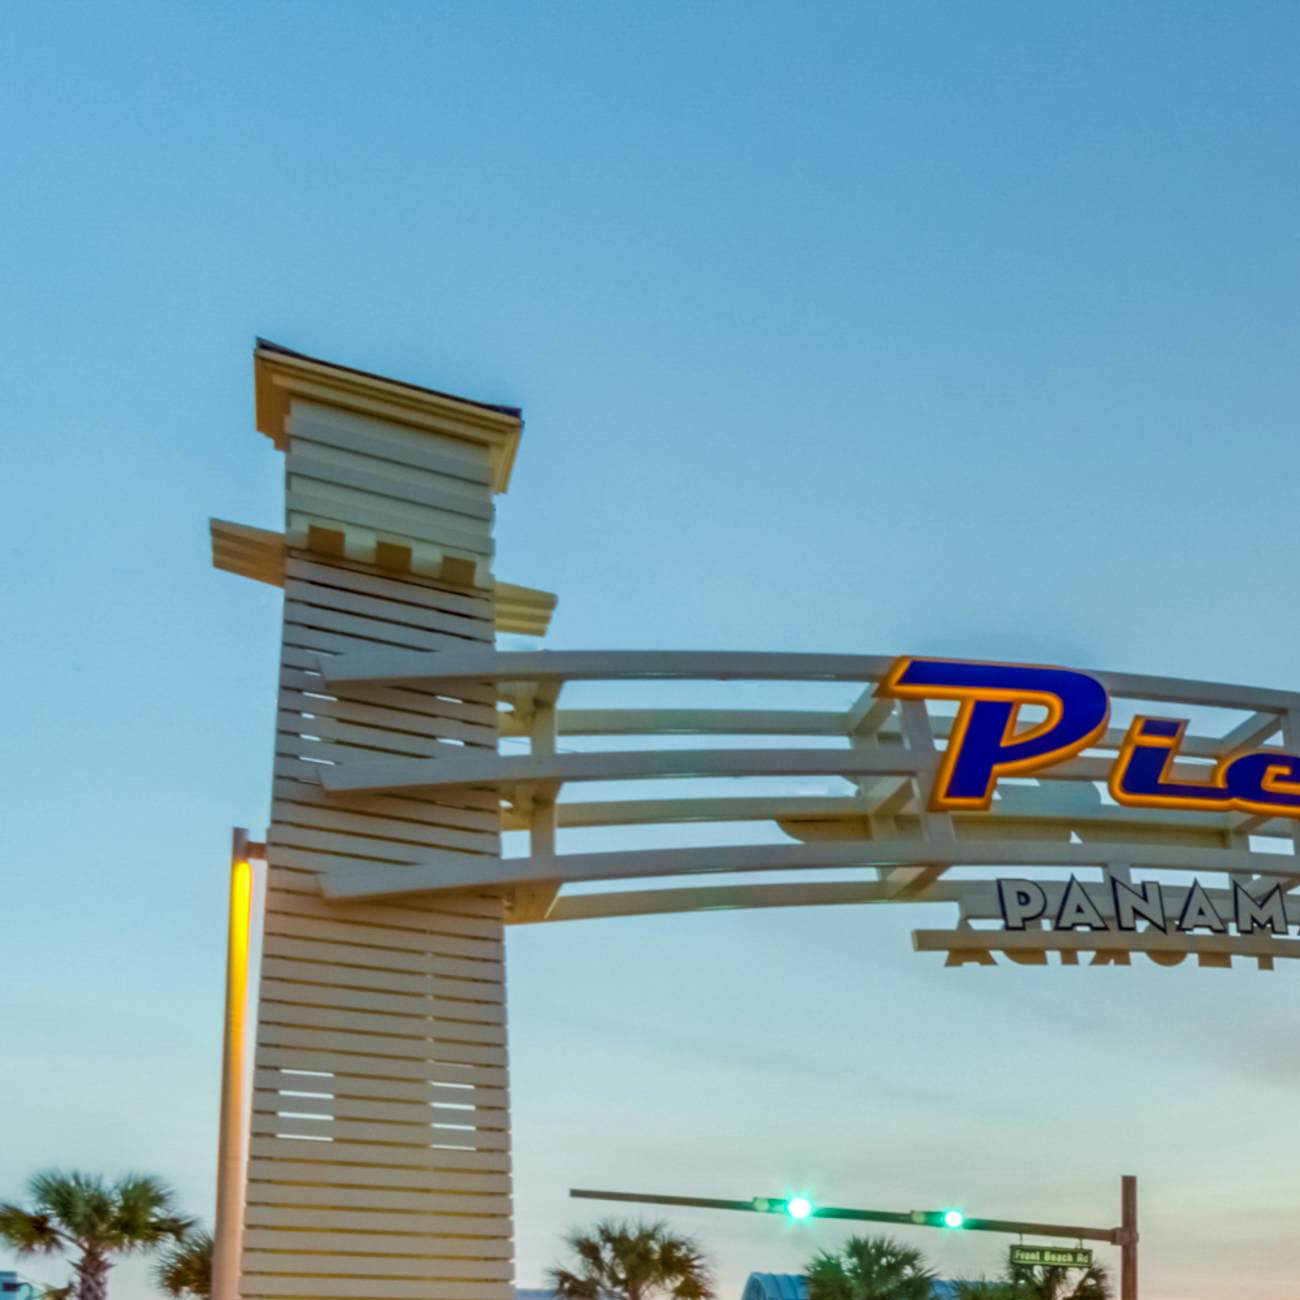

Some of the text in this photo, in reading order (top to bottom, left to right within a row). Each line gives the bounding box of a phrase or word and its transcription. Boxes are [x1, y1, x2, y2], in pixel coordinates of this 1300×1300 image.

[1015, 1249, 1089, 1263] Front Beach Rd
